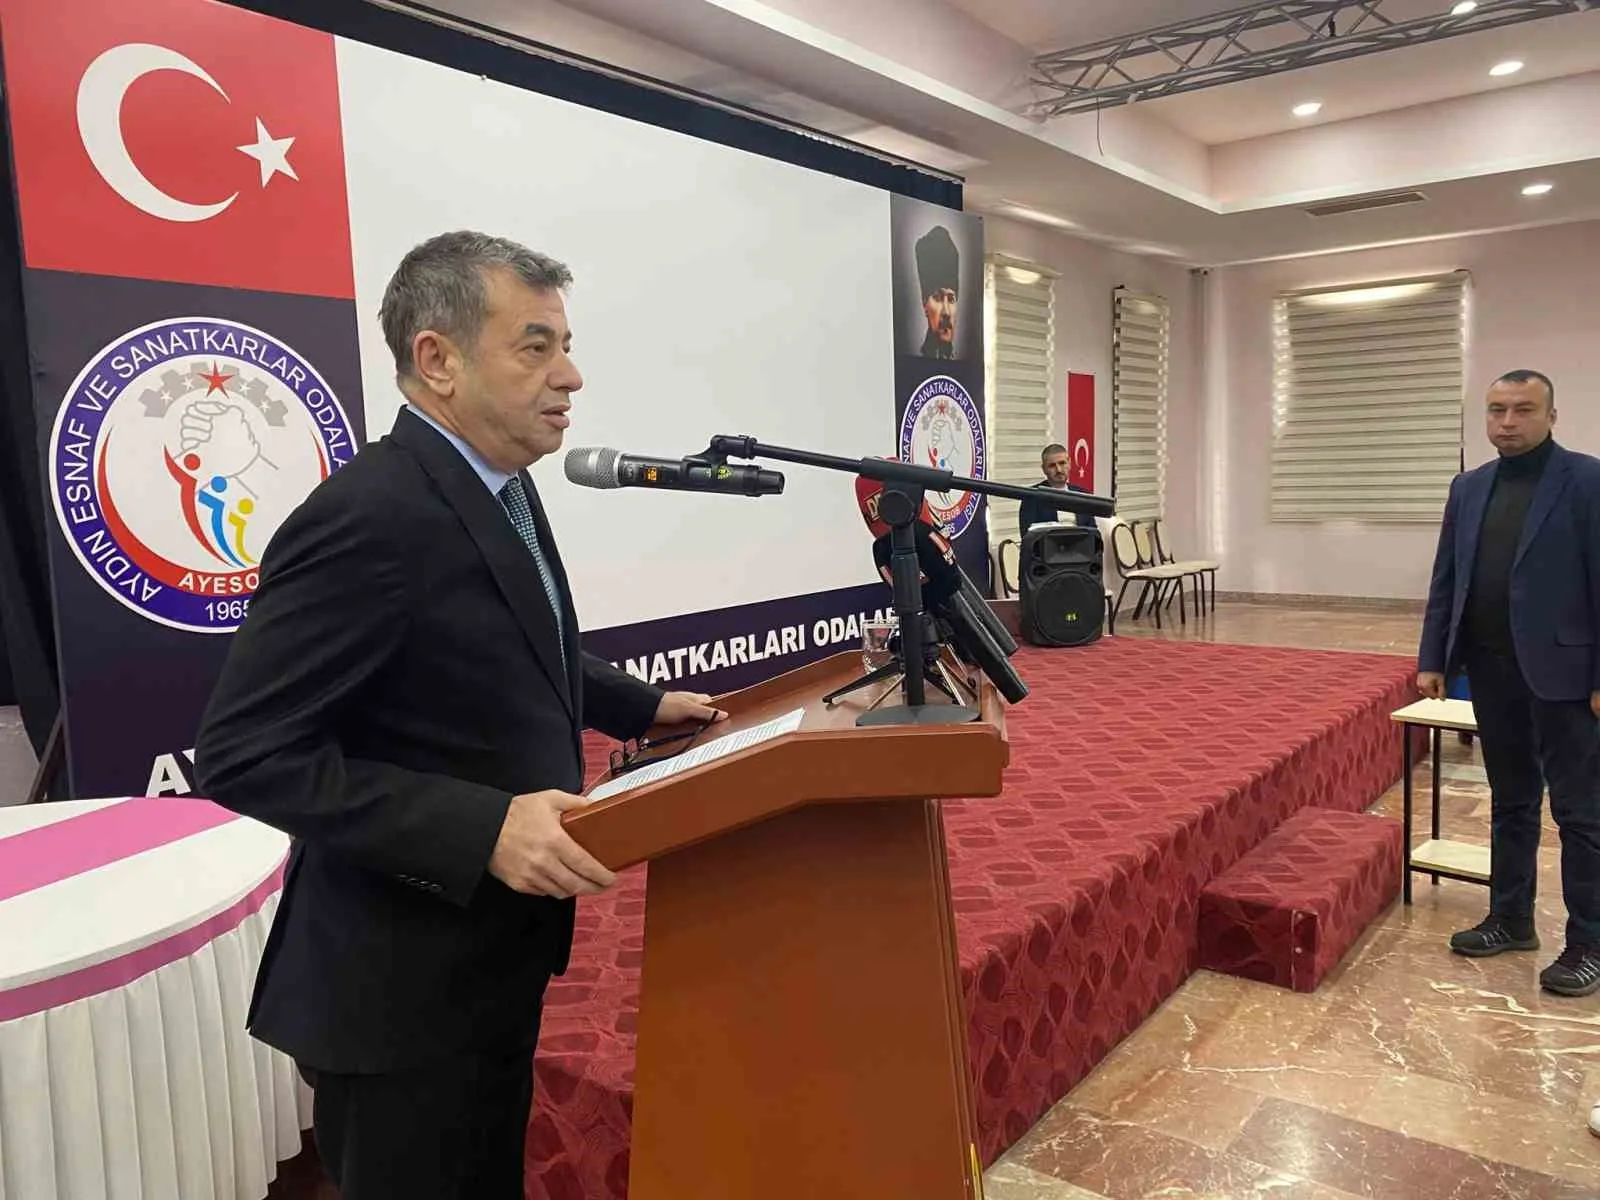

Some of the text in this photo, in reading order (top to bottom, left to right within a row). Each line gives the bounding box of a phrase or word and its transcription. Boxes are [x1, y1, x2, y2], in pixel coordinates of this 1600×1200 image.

[111, 328, 306, 390] SANATKARLAR
[77, 374, 117, 412] VE
[905, 409, 917, 429] VE
[913, 381, 969, 411] SANATKARLAR
[967, 409, 983, 470] ODALARI
[63, 418, 98, 524] ESNAF
[83, 530, 162, 602] AYDIN
[609, 624, 806, 685] NATKARLARI
